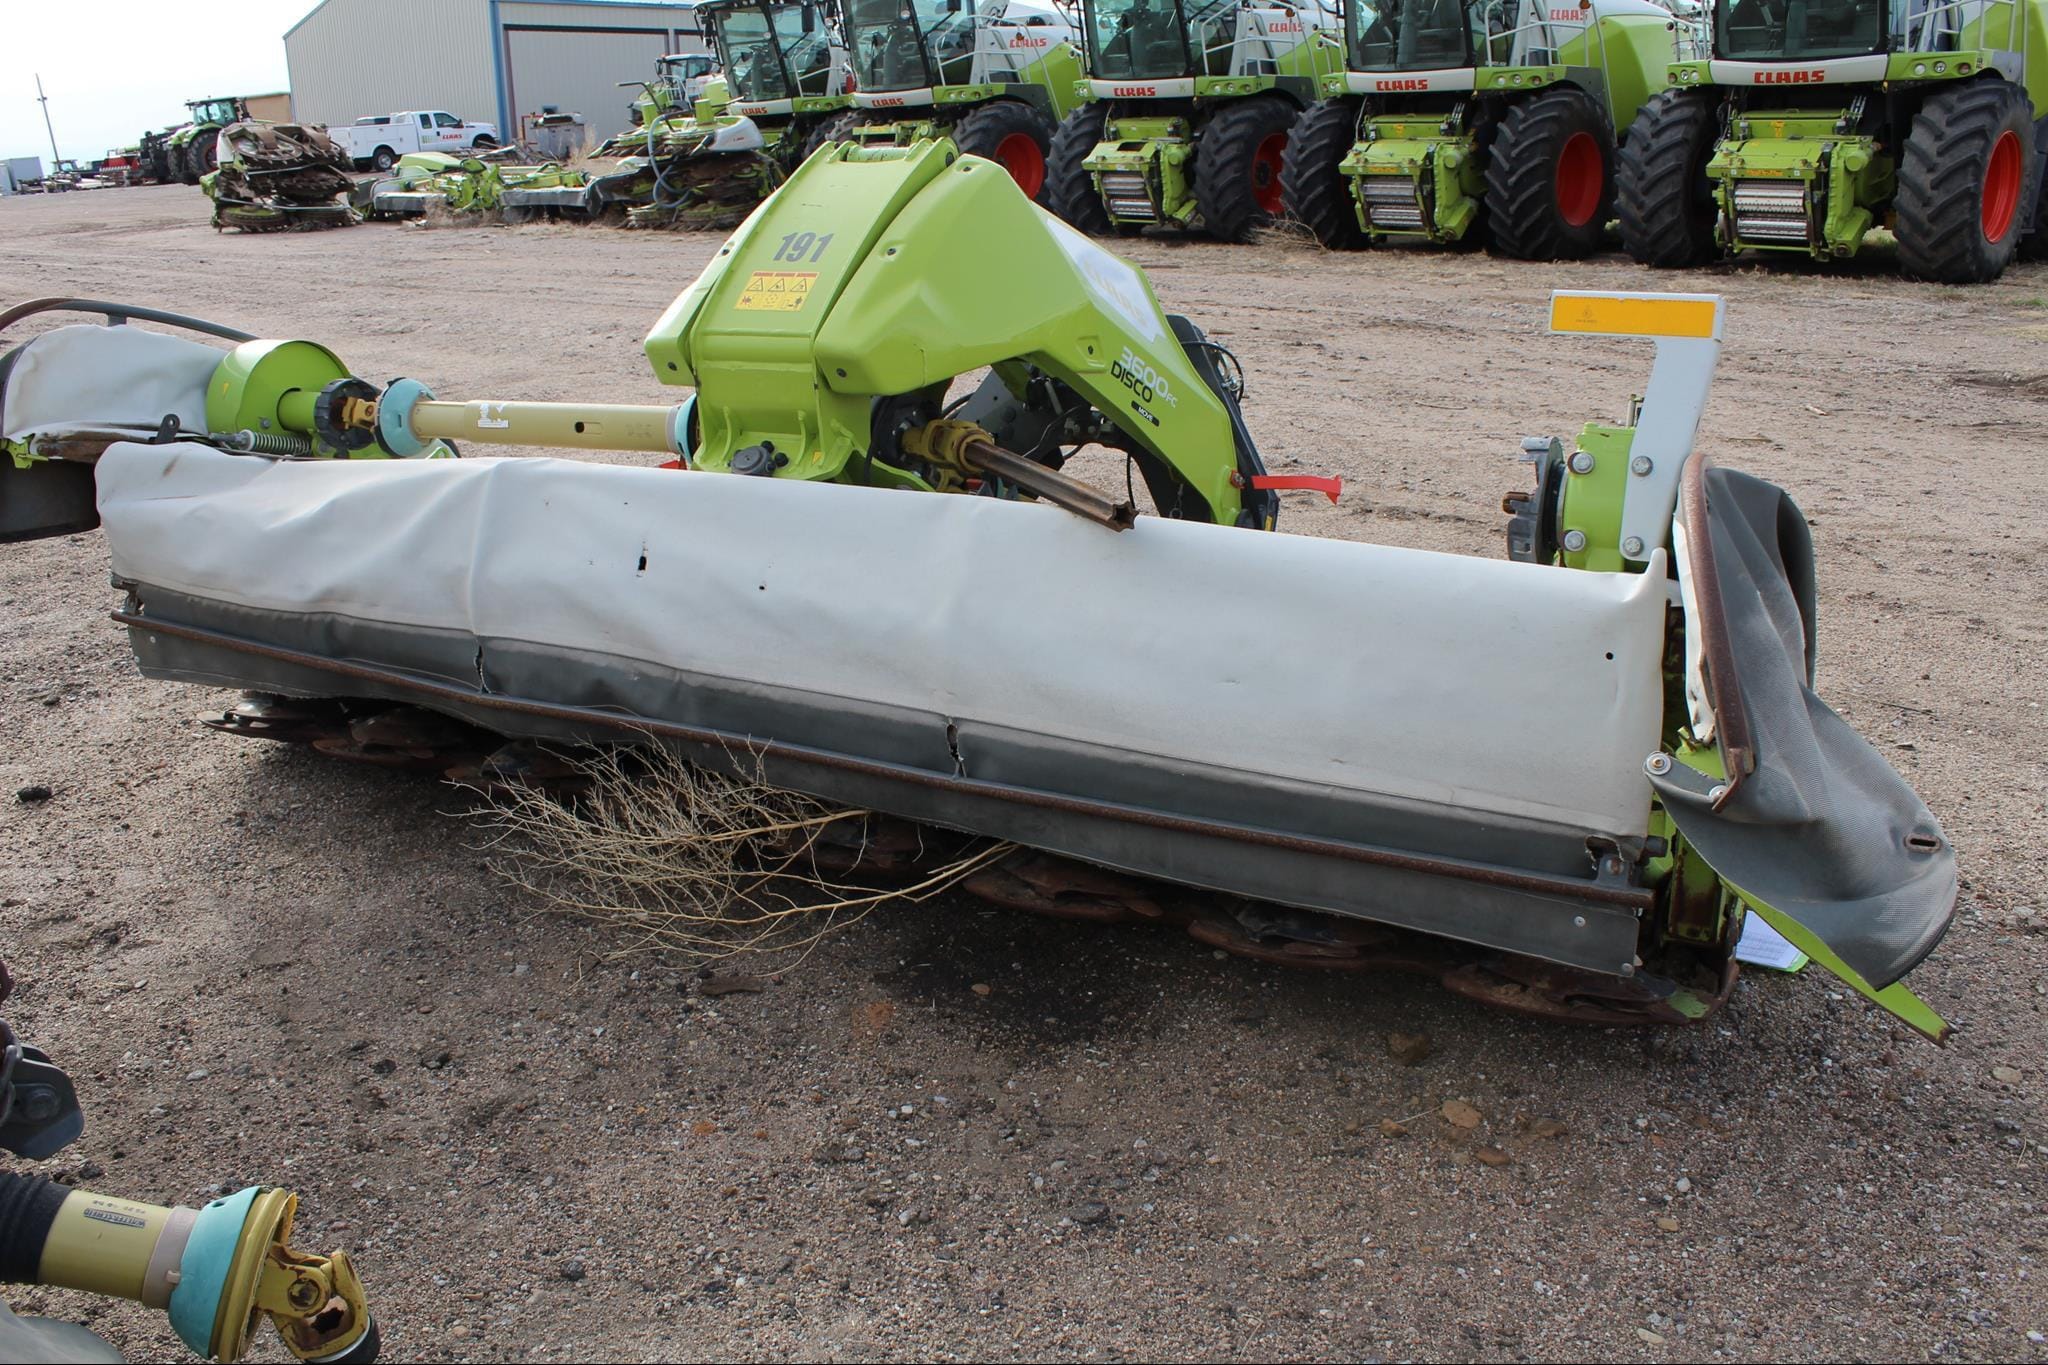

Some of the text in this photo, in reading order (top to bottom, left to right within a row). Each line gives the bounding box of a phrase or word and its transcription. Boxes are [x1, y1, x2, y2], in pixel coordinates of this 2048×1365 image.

[1754, 70, 1825, 84] CLAAS
[1376, 79, 1428, 91] CLAAS
[1114, 87, 1156, 97] CLAAS
[871, 98, 905, 107] CLAAS
[741, 107, 768, 115] CLAAS
[773, 232, 834, 263] 191
[1111, 360, 1152, 403] DISCO
